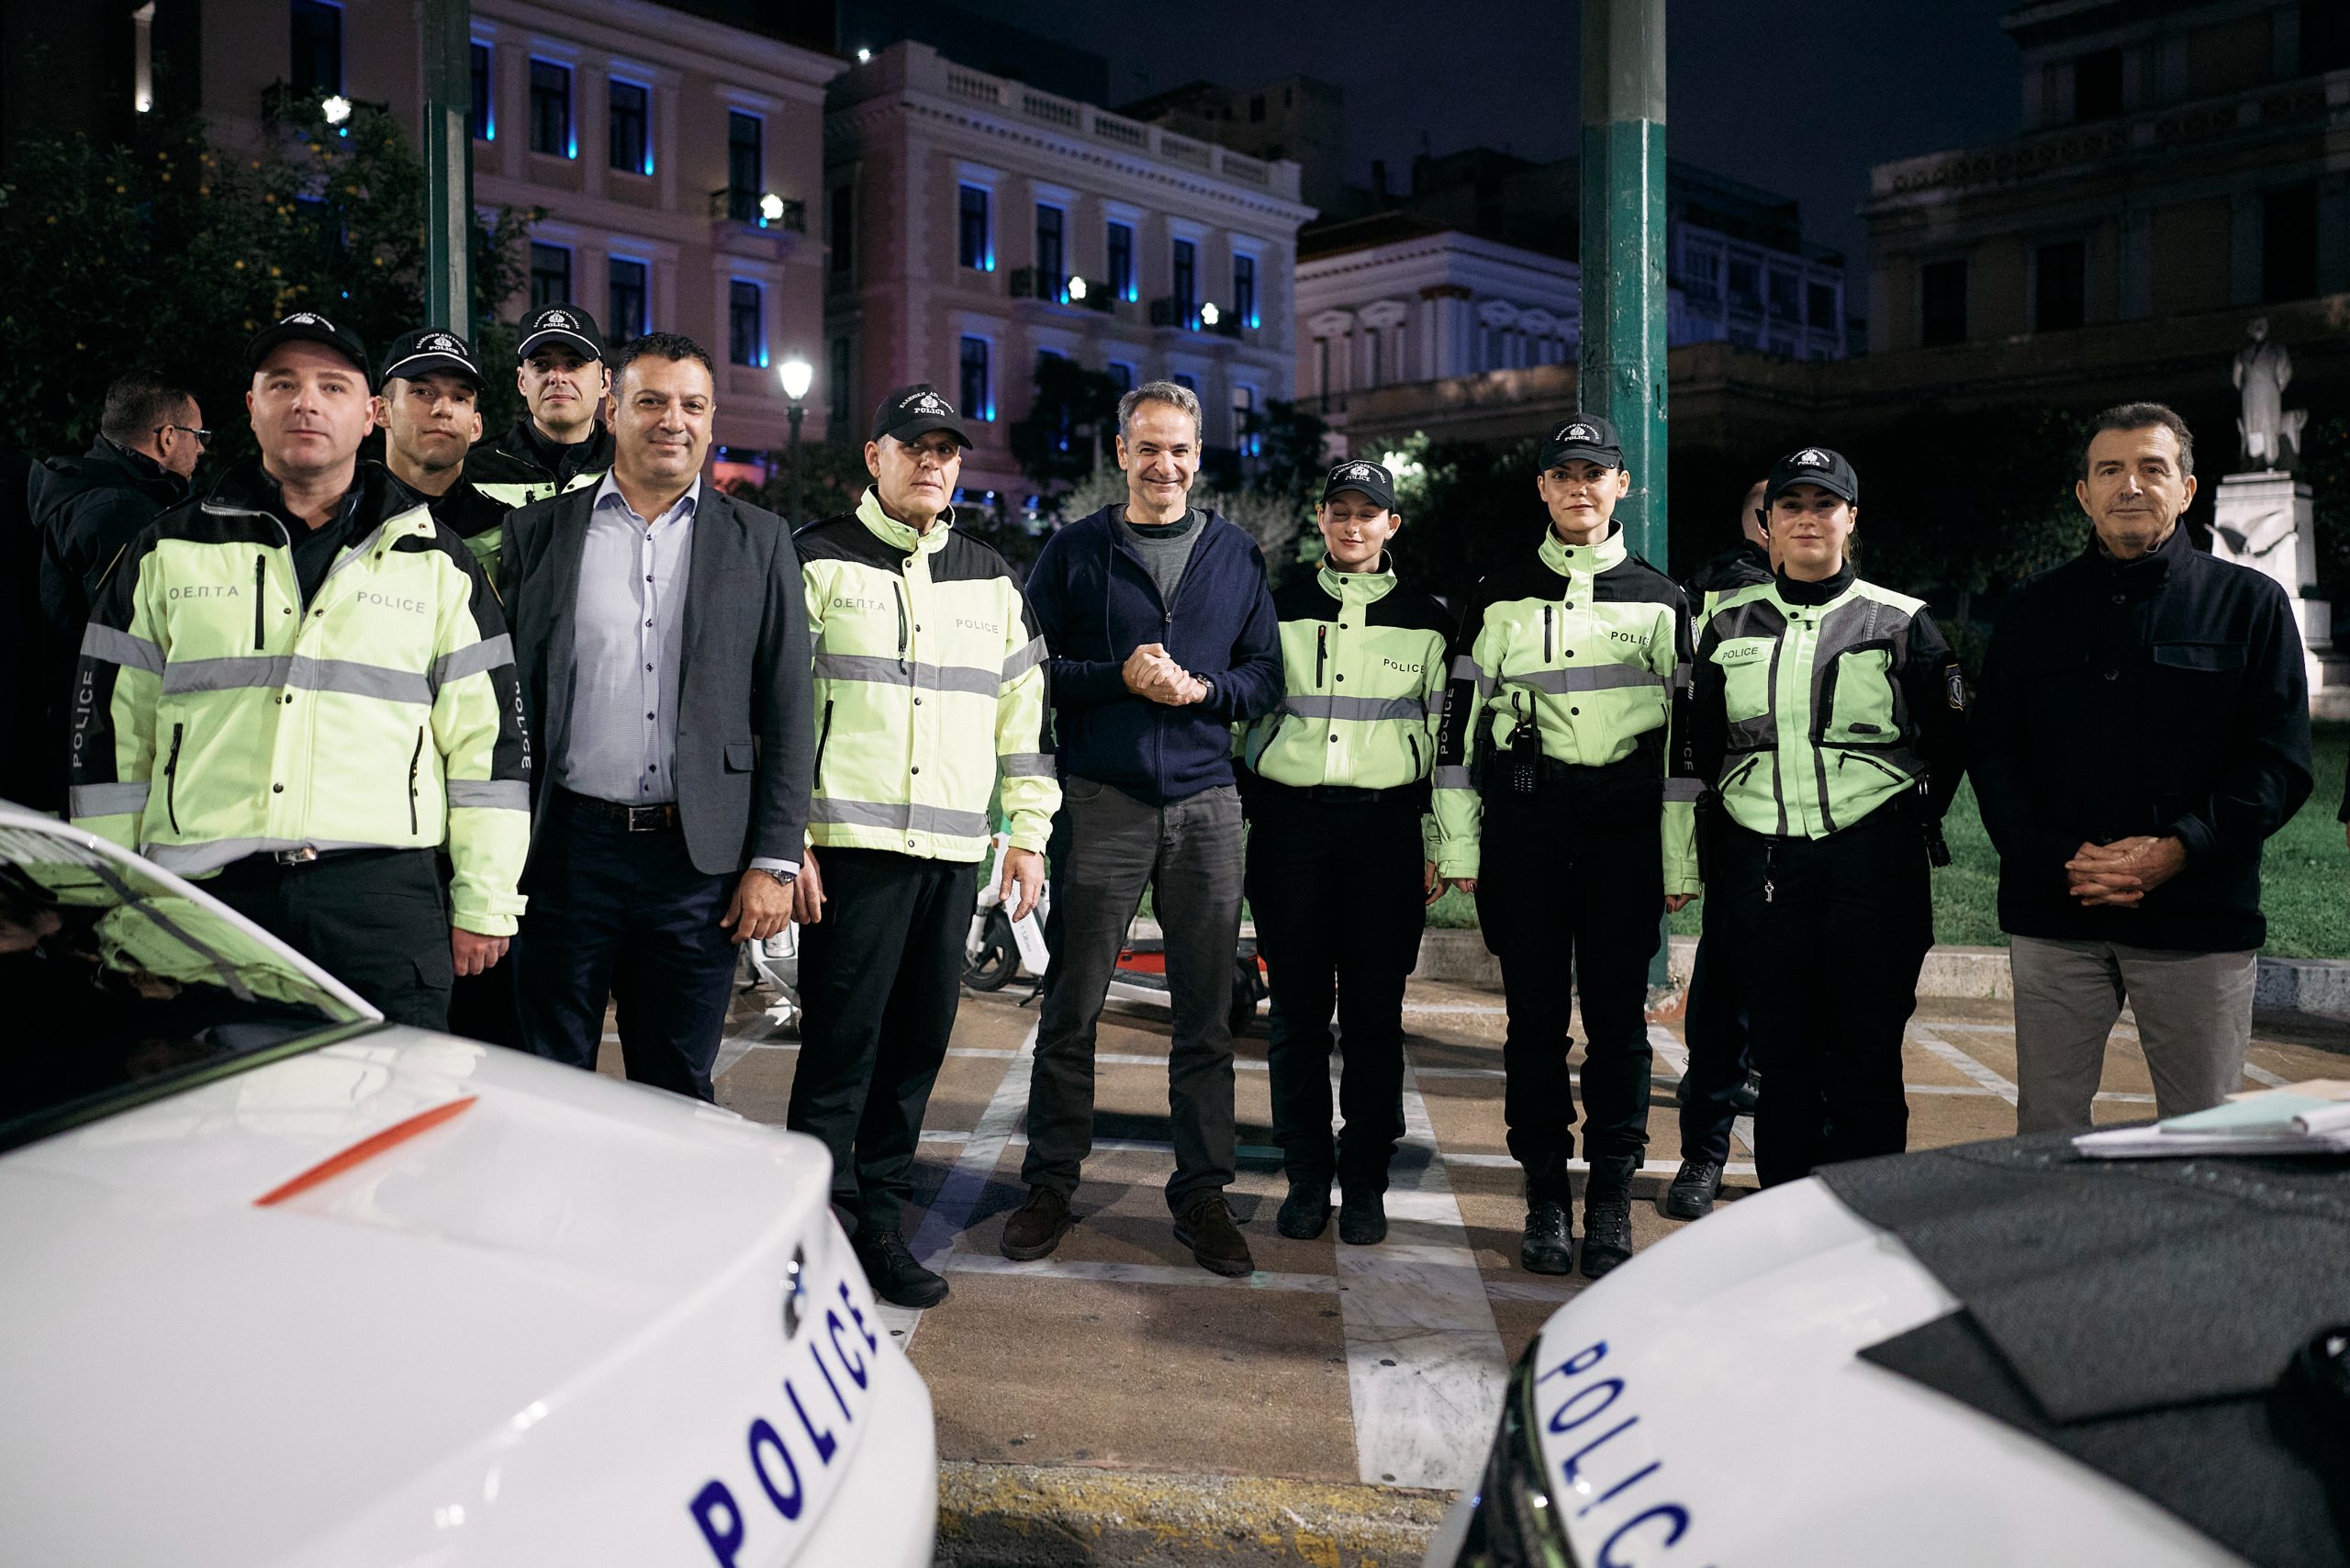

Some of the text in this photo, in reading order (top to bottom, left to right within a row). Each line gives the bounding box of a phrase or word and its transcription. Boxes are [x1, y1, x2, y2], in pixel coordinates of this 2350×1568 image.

[429, 345, 459, 354] POLICE
[913, 407, 946, 417] POLICE
[1345, 475, 1371, 483] POLICE
[357, 591, 426, 614] POLICE
[956, 618, 1000, 634] POLICE
[1722, 646, 1760, 661] POLICE
[73, 671, 93, 767] POLICE
[1440, 688, 1455, 755] POLICE
[689, 1280, 877, 1568] POLICE
